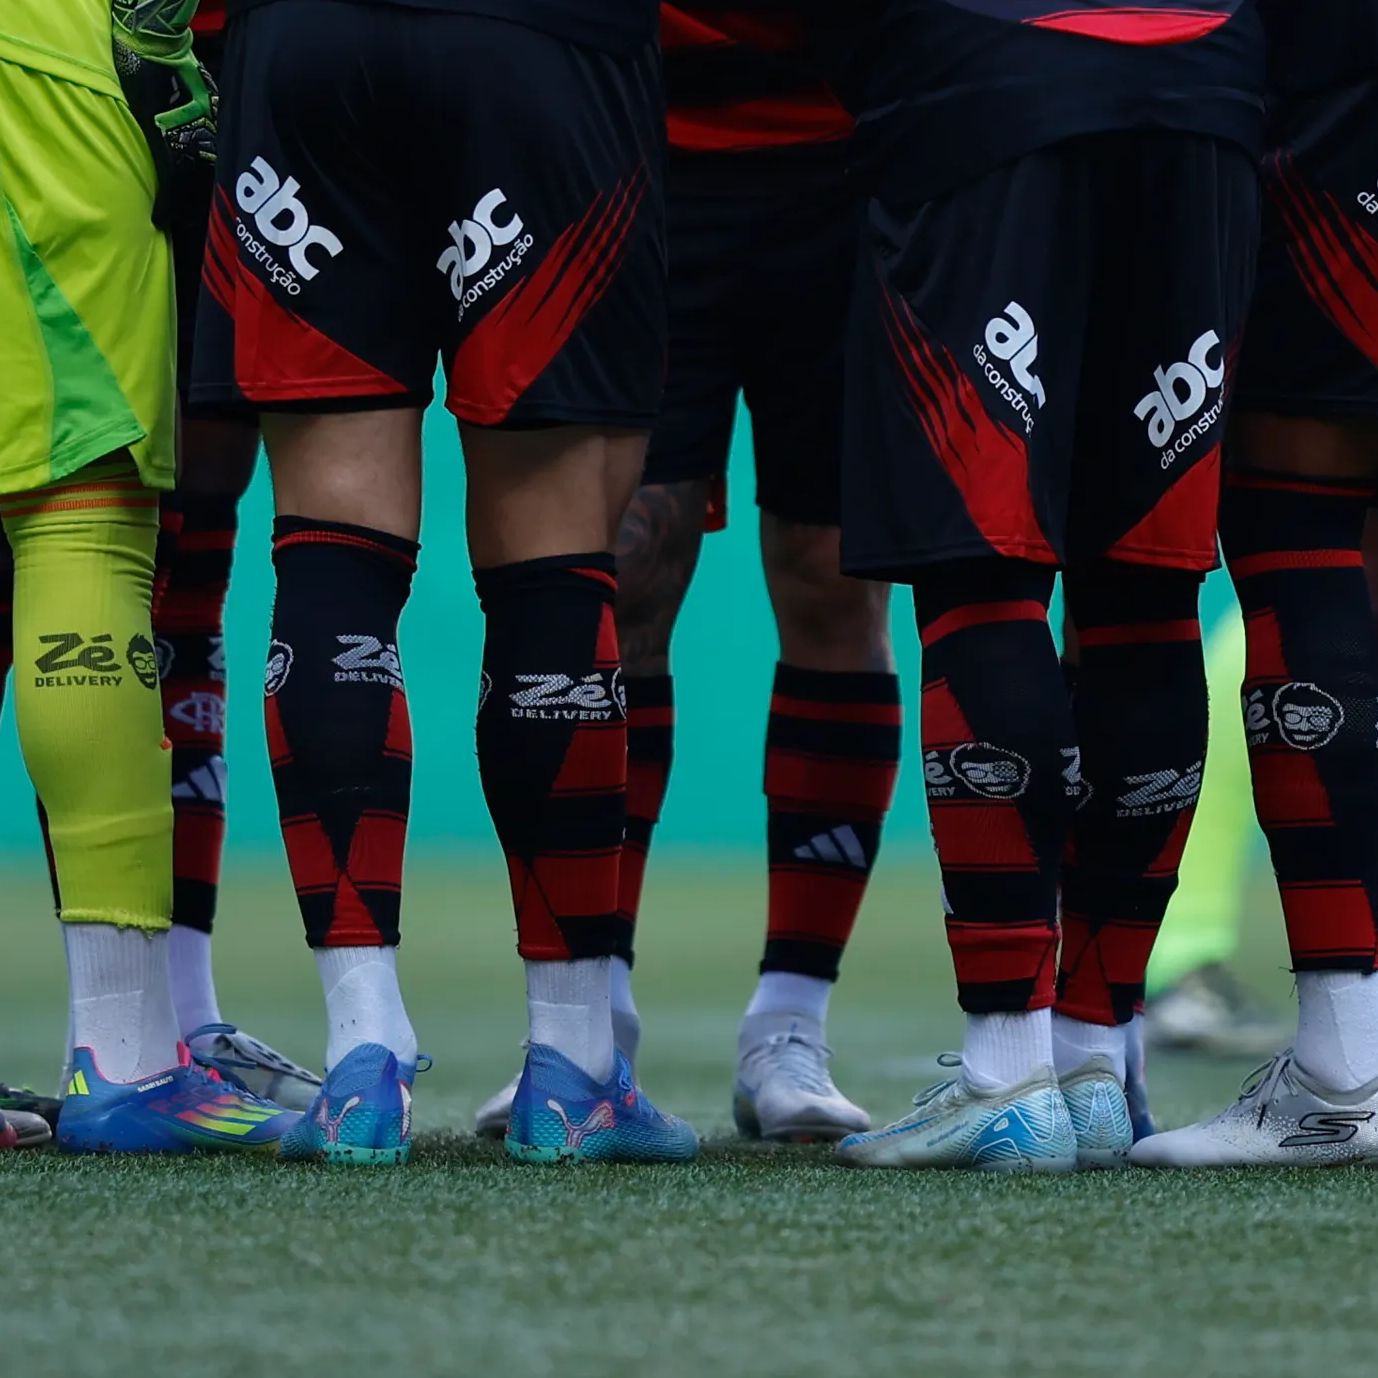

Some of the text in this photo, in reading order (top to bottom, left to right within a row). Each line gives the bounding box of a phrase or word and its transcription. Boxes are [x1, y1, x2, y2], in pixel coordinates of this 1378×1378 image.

[235, 154, 344, 282] abc
[461, 233, 534, 309] construção
[972, 343, 1035, 439] da construç
[1159, 448, 1176, 470] da
[35, 632, 122, 674] Zé
[34, 675, 122, 688] DELIVERY
[509, 672, 613, 709] Zé
[509, 708, 613, 721] DELIVERY
